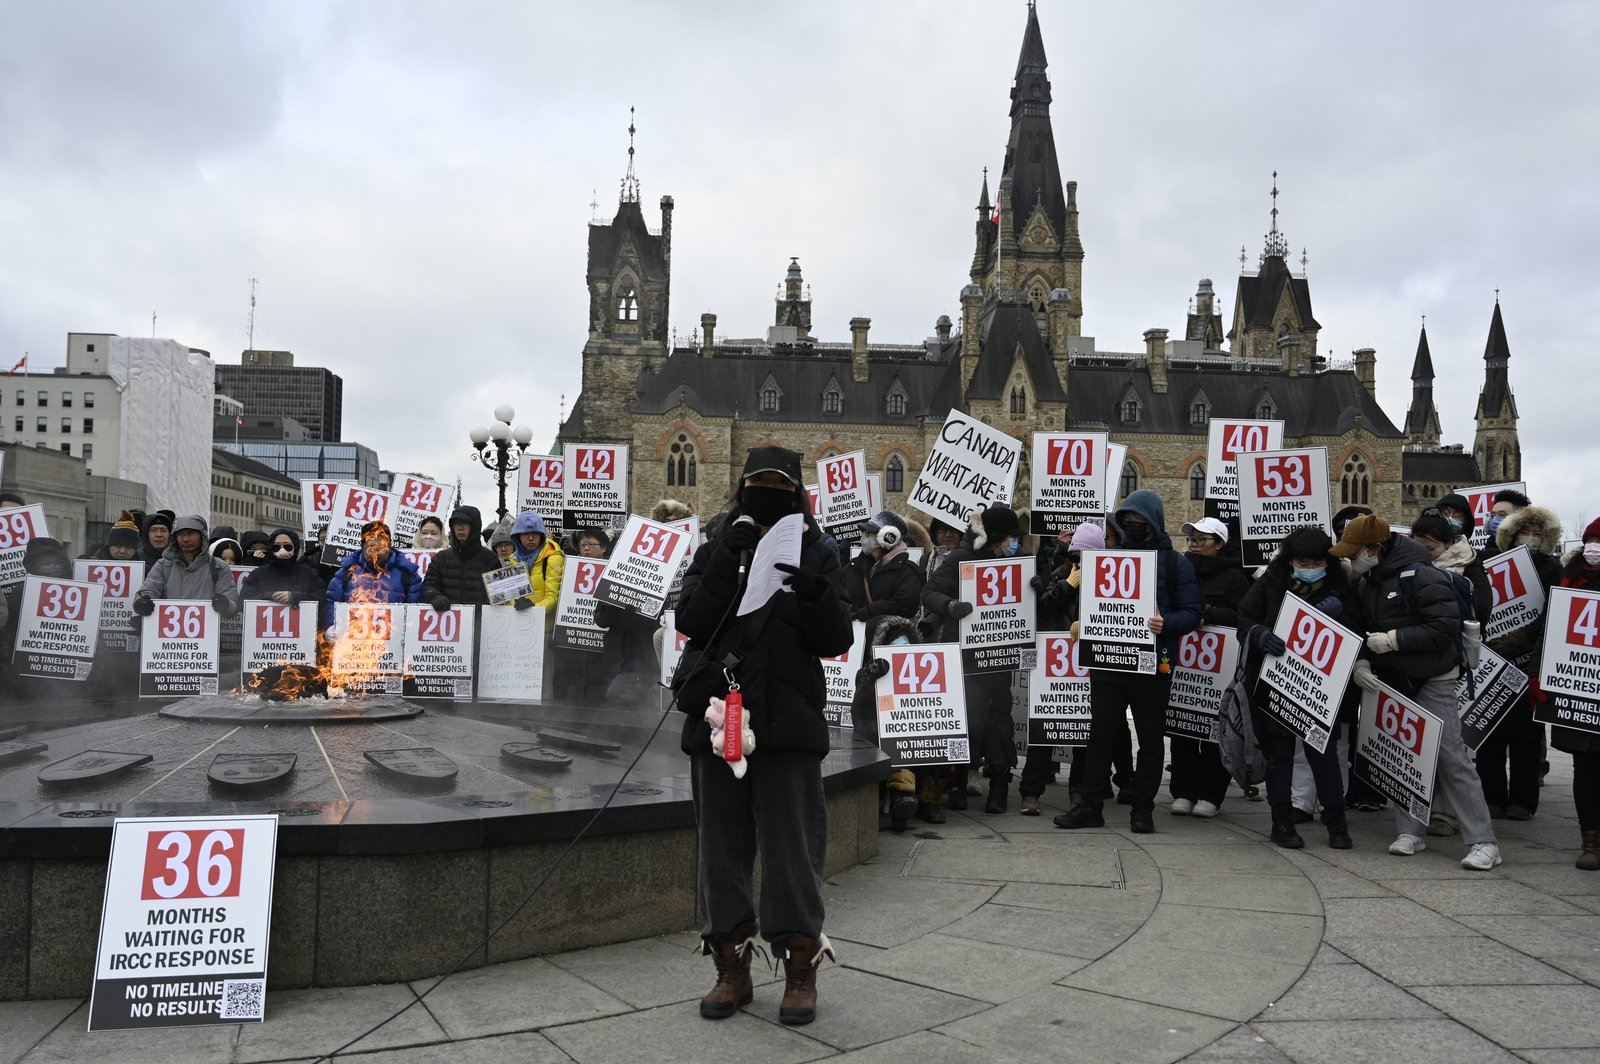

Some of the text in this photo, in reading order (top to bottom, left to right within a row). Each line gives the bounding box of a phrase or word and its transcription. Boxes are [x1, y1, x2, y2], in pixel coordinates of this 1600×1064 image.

[1226, 426, 1263, 452] 40
[942, 420, 1015, 473] CANADA
[1054, 440, 1087, 475] 70
[580, 450, 610, 480] 42
[533, 460, 563, 489] 42
[831, 460, 855, 493] 39
[926, 449, 997, 500] WHAT ARE
[1264, 457, 1304, 496] 53
[579, 483, 610, 491] MONTHS
[1050, 479, 1086, 488] MONTHS
[406, 481, 436, 511] 34
[533, 491, 563, 499] MONTHS
[571, 491, 602, 499] WAITING
[832, 492, 856, 504] MONTHS
[913, 479, 974, 523] YOU DOING
[1041, 489, 1095, 499] WAITING FOR
[350, 491, 384, 521] 30
[526, 499, 555, 507] WAITING
[827, 500, 863, 514] WAITING FOR
[1036, 499, 1100, 509] IRCC RESPONSE
[1262, 501, 1306, 511] MONTHS
[825, 509, 867, 523] IRCC RESPONSE
[1252, 512, 1318, 523] WAITING FOR
[1247, 525, 1269, 535] IRCC
[636, 527, 672, 561] 51
[1258, 542, 1270, 550] NO
[627, 556, 660, 572] MONTHS
[616, 563, 664, 583] WAITING FOR
[1100, 558, 1136, 598] 30
[93, 566, 129, 597] 39
[608, 570, 665, 594] IRCC RESPONSE
[982, 566, 1016, 606] 31
[43, 585, 82, 619] 39
[1098, 602, 1135, 614] MONTHS
[980, 609, 1017, 621] MONTHS
[1487, 601, 1526, 624] MONTHS
[1520, 608, 1540, 624] FOR
[39, 621, 78, 632] MONTHS
[163, 606, 200, 638] 36
[261, 607, 294, 638] 11
[422, 610, 459, 642] 20
[971, 619, 1026, 633] WAITING FOR
[1089, 614, 1144, 627] WAITING FOR
[28, 630, 86, 643] WAITING FOR
[966, 630, 1031, 645] IRCC RESPONSE
[1084, 626, 1149, 639] IRCC RESPONSE
[21, 640, 91, 654] IRCC RESPONSE
[162, 642, 199, 650] MONTHS
[261, 642, 298, 650] MONTHS
[1092, 644, 1102, 652] NO
[1294, 615, 1335, 668] 90
[152, 652, 208, 660] WAITING FOR
[252, 652, 288, 660] WAITING
[422, 645, 455, 653] MONTHS
[975, 650, 985, 659] NO
[1180, 632, 1218, 670] 68
[28, 655, 40, 663] NO
[413, 654, 446, 663] WAITING
[978, 657, 1020, 668] NO RESULTS
[1095, 654, 1137, 665] NO RESULTS
[30, 664, 76, 675] NO RESULTS
[146, 662, 213, 670] IRCC RESPONSE
[426, 664, 467, 673] RESPONSE
[899, 653, 940, 693] 42
[1286, 655, 1323, 687] MONTHS
[832, 677, 849, 687] FOR
[1176, 671, 1213, 686] MONTHS
[1273, 660, 1328, 705] WAITING FOR
[1546, 675, 1572, 689] IRCC
[1050, 682, 1090, 692] MONTHS
[1203, 687, 1222, 699] FOR
[1265, 668, 1329, 719] IRCC RESPONSE
[900, 698, 942, 709] MONTHS
[1040, 694, 1079, 703] WAITING
[1269, 690, 1280, 703] NO
[1485, 687, 1513, 719] RESULTS
[1555, 697, 1569, 709] NO
[890, 709, 954, 721] WAITING FOR
[1034, 705, 1055, 714] IRCC
[1557, 709, 1571, 720] NO
[1269, 701, 1310, 735] NO RESULTS
[1385, 699, 1418, 747] 65
[728, 705, 738, 756] lululemon
[885, 721, 961, 734] IRCC RESPONSE
[1177, 720, 1210, 735] RESULTS
[896, 740, 908, 749] NO
[1378, 733, 1414, 765] MONTHS
[900, 749, 949, 759] NO RESULTS
[1367, 737, 1422, 781] WAITING FOR
[1362, 744, 1426, 795] IRCC RESPONSE
[153, 831, 234, 898] 36
[147, 907, 227, 925] MONTHS
[123, 928, 246, 948] WAITING FOR
[109, 948, 255, 970] IRCC RESPONSE
[125, 981, 224, 999] NO TIMELINE
[130, 1000, 223, 1018] NO RESULTS
